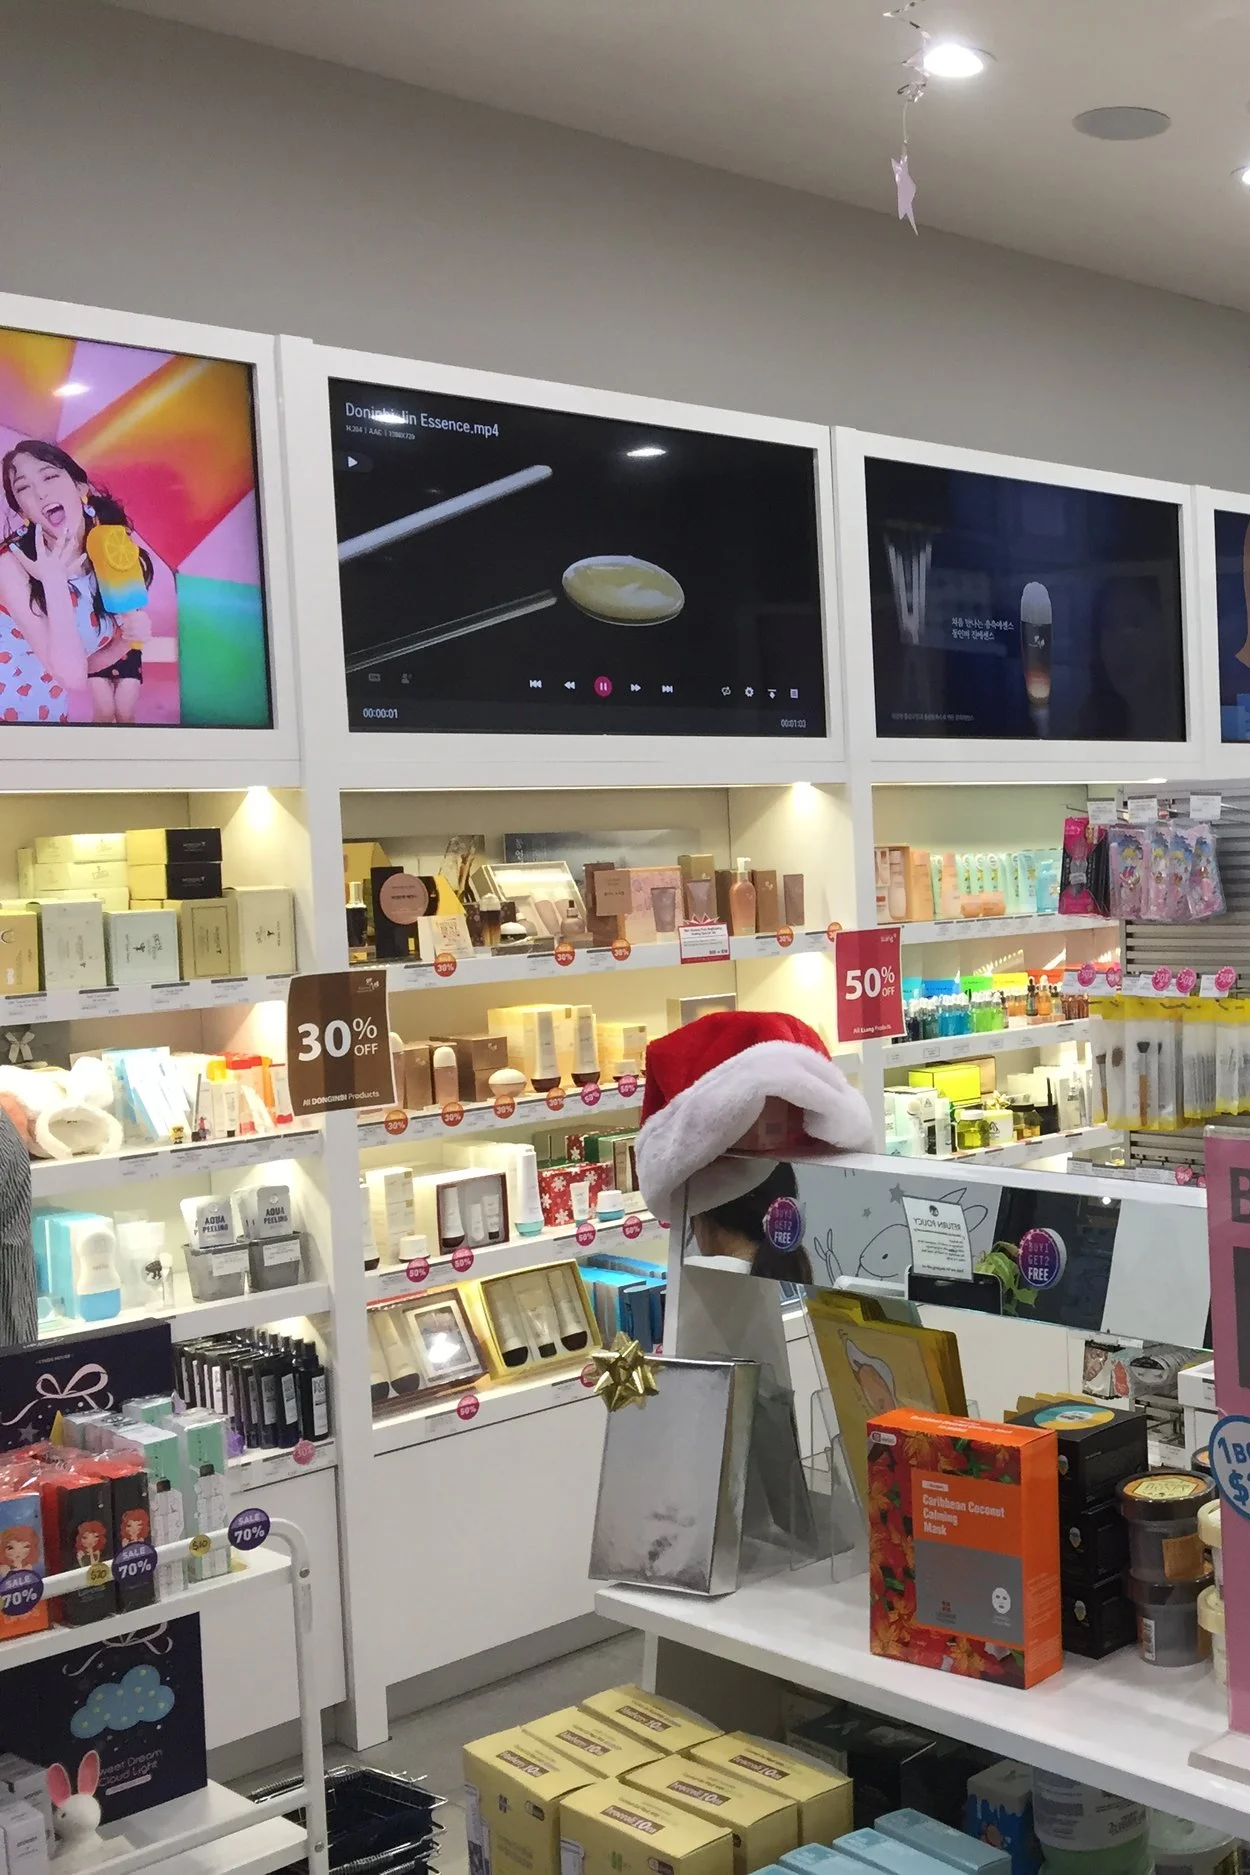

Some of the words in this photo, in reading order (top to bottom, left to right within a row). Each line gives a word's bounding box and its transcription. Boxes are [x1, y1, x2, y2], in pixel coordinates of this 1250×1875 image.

[420, 413, 500, 438] Essence.mp4
[362, 707, 399, 719] 00:00:01
[845, 965, 895, 1001] 50%
[881, 986, 896, 997] OFF
[297, 1016, 378, 1061] 30%
[354, 1043, 379, 1056] OFF
[348, 1090, 380, 1101] Products
[265, 1206, 286, 1217] AQUA
[204, 1215, 226, 1226] AQUA
[263, 1215, 289, 1225] PEELING
[202, 1223, 229, 1233] PEELING
[774, 1231, 792, 1244] FREE
[1028, 1267, 1049, 1281] FREE
[922, 1493, 967, 1512] Caribbean
[968, 1502, 1005, 1519] Coconut
[239, 1512, 262, 1526] SALE
[923, 1508, 958, 1526] Calming
[234, 1526, 266, 1543] 70%
[924, 1521, 948, 1536] Mask
[121, 1546, 146, 1560] SALE
[118, 1560, 152, 1579] 70%
[5, 1575, 31, 1588] SALE
[1, 1590, 37, 1608] 70%
[127, 1749, 164, 1767] Dream
